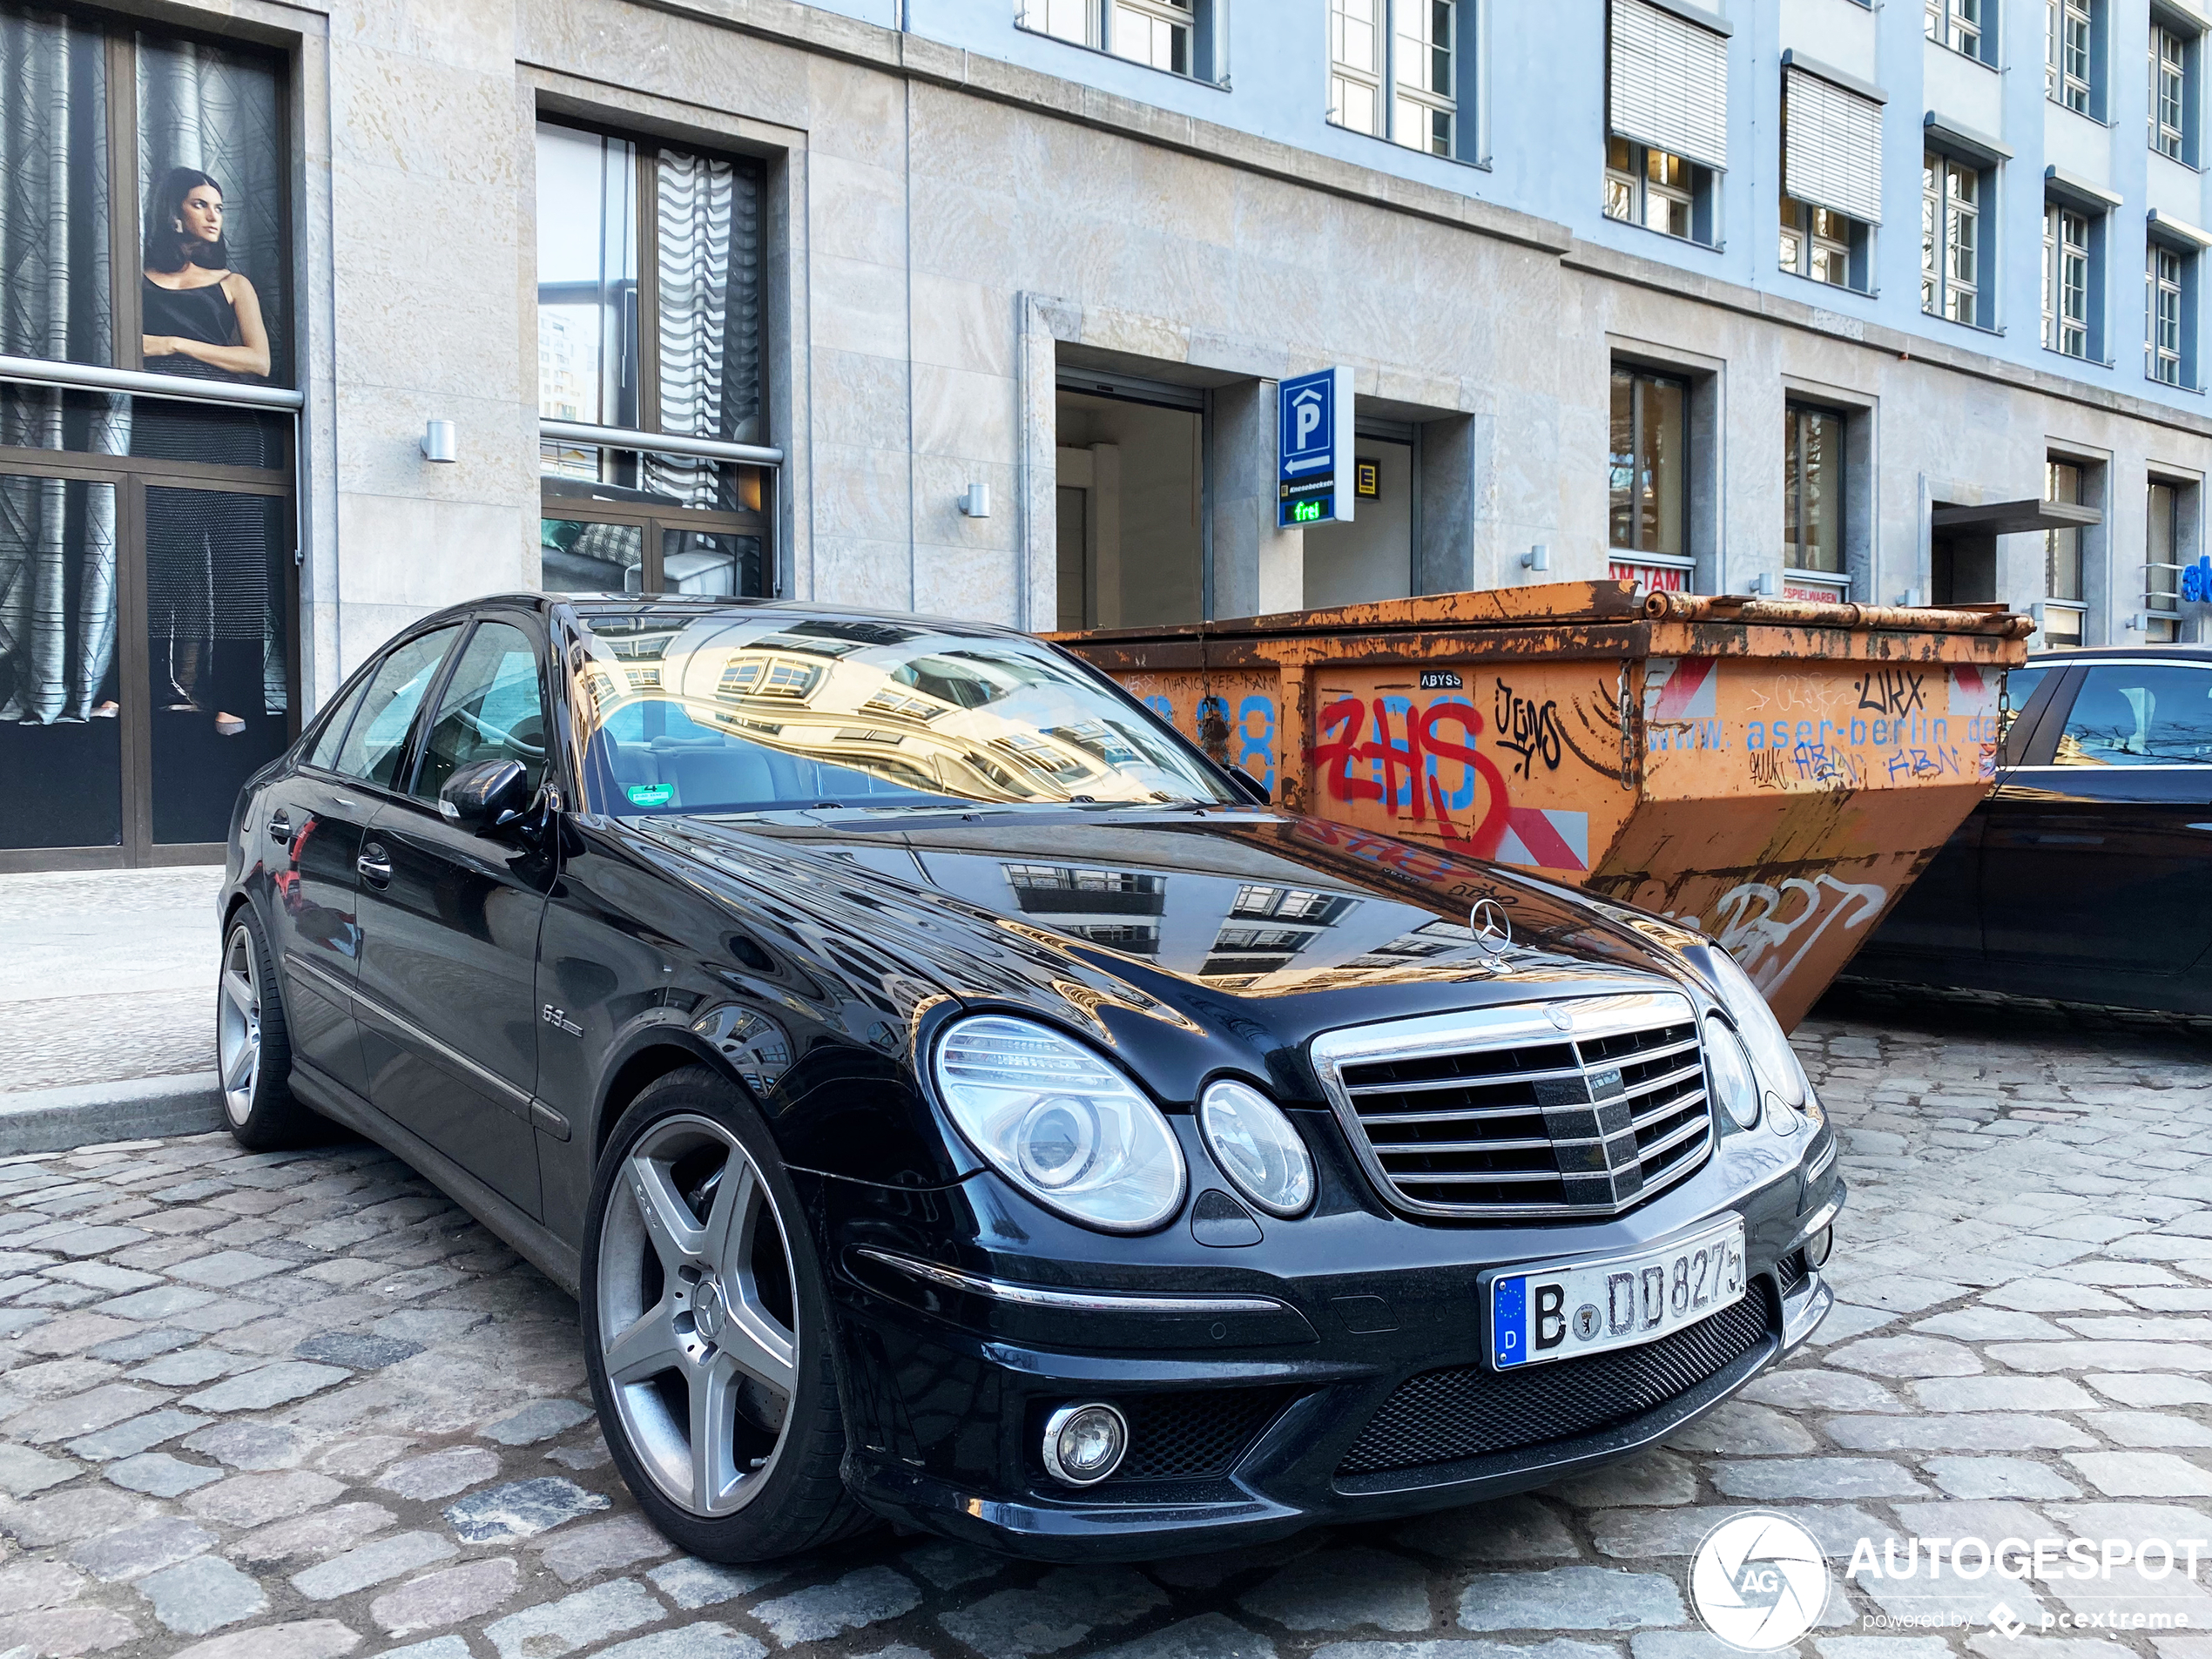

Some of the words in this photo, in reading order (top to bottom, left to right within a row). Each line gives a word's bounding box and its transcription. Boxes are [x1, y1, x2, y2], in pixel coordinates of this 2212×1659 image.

[1297, 403, 1320, 450] P
[1295, 501, 1320, 521] frei
[1641, 566, 1680, 591] TAM
[542, 1004, 565, 1028] 63
[1534, 1284, 1567, 1351] B
[1505, 1330, 1517, 1350] D
